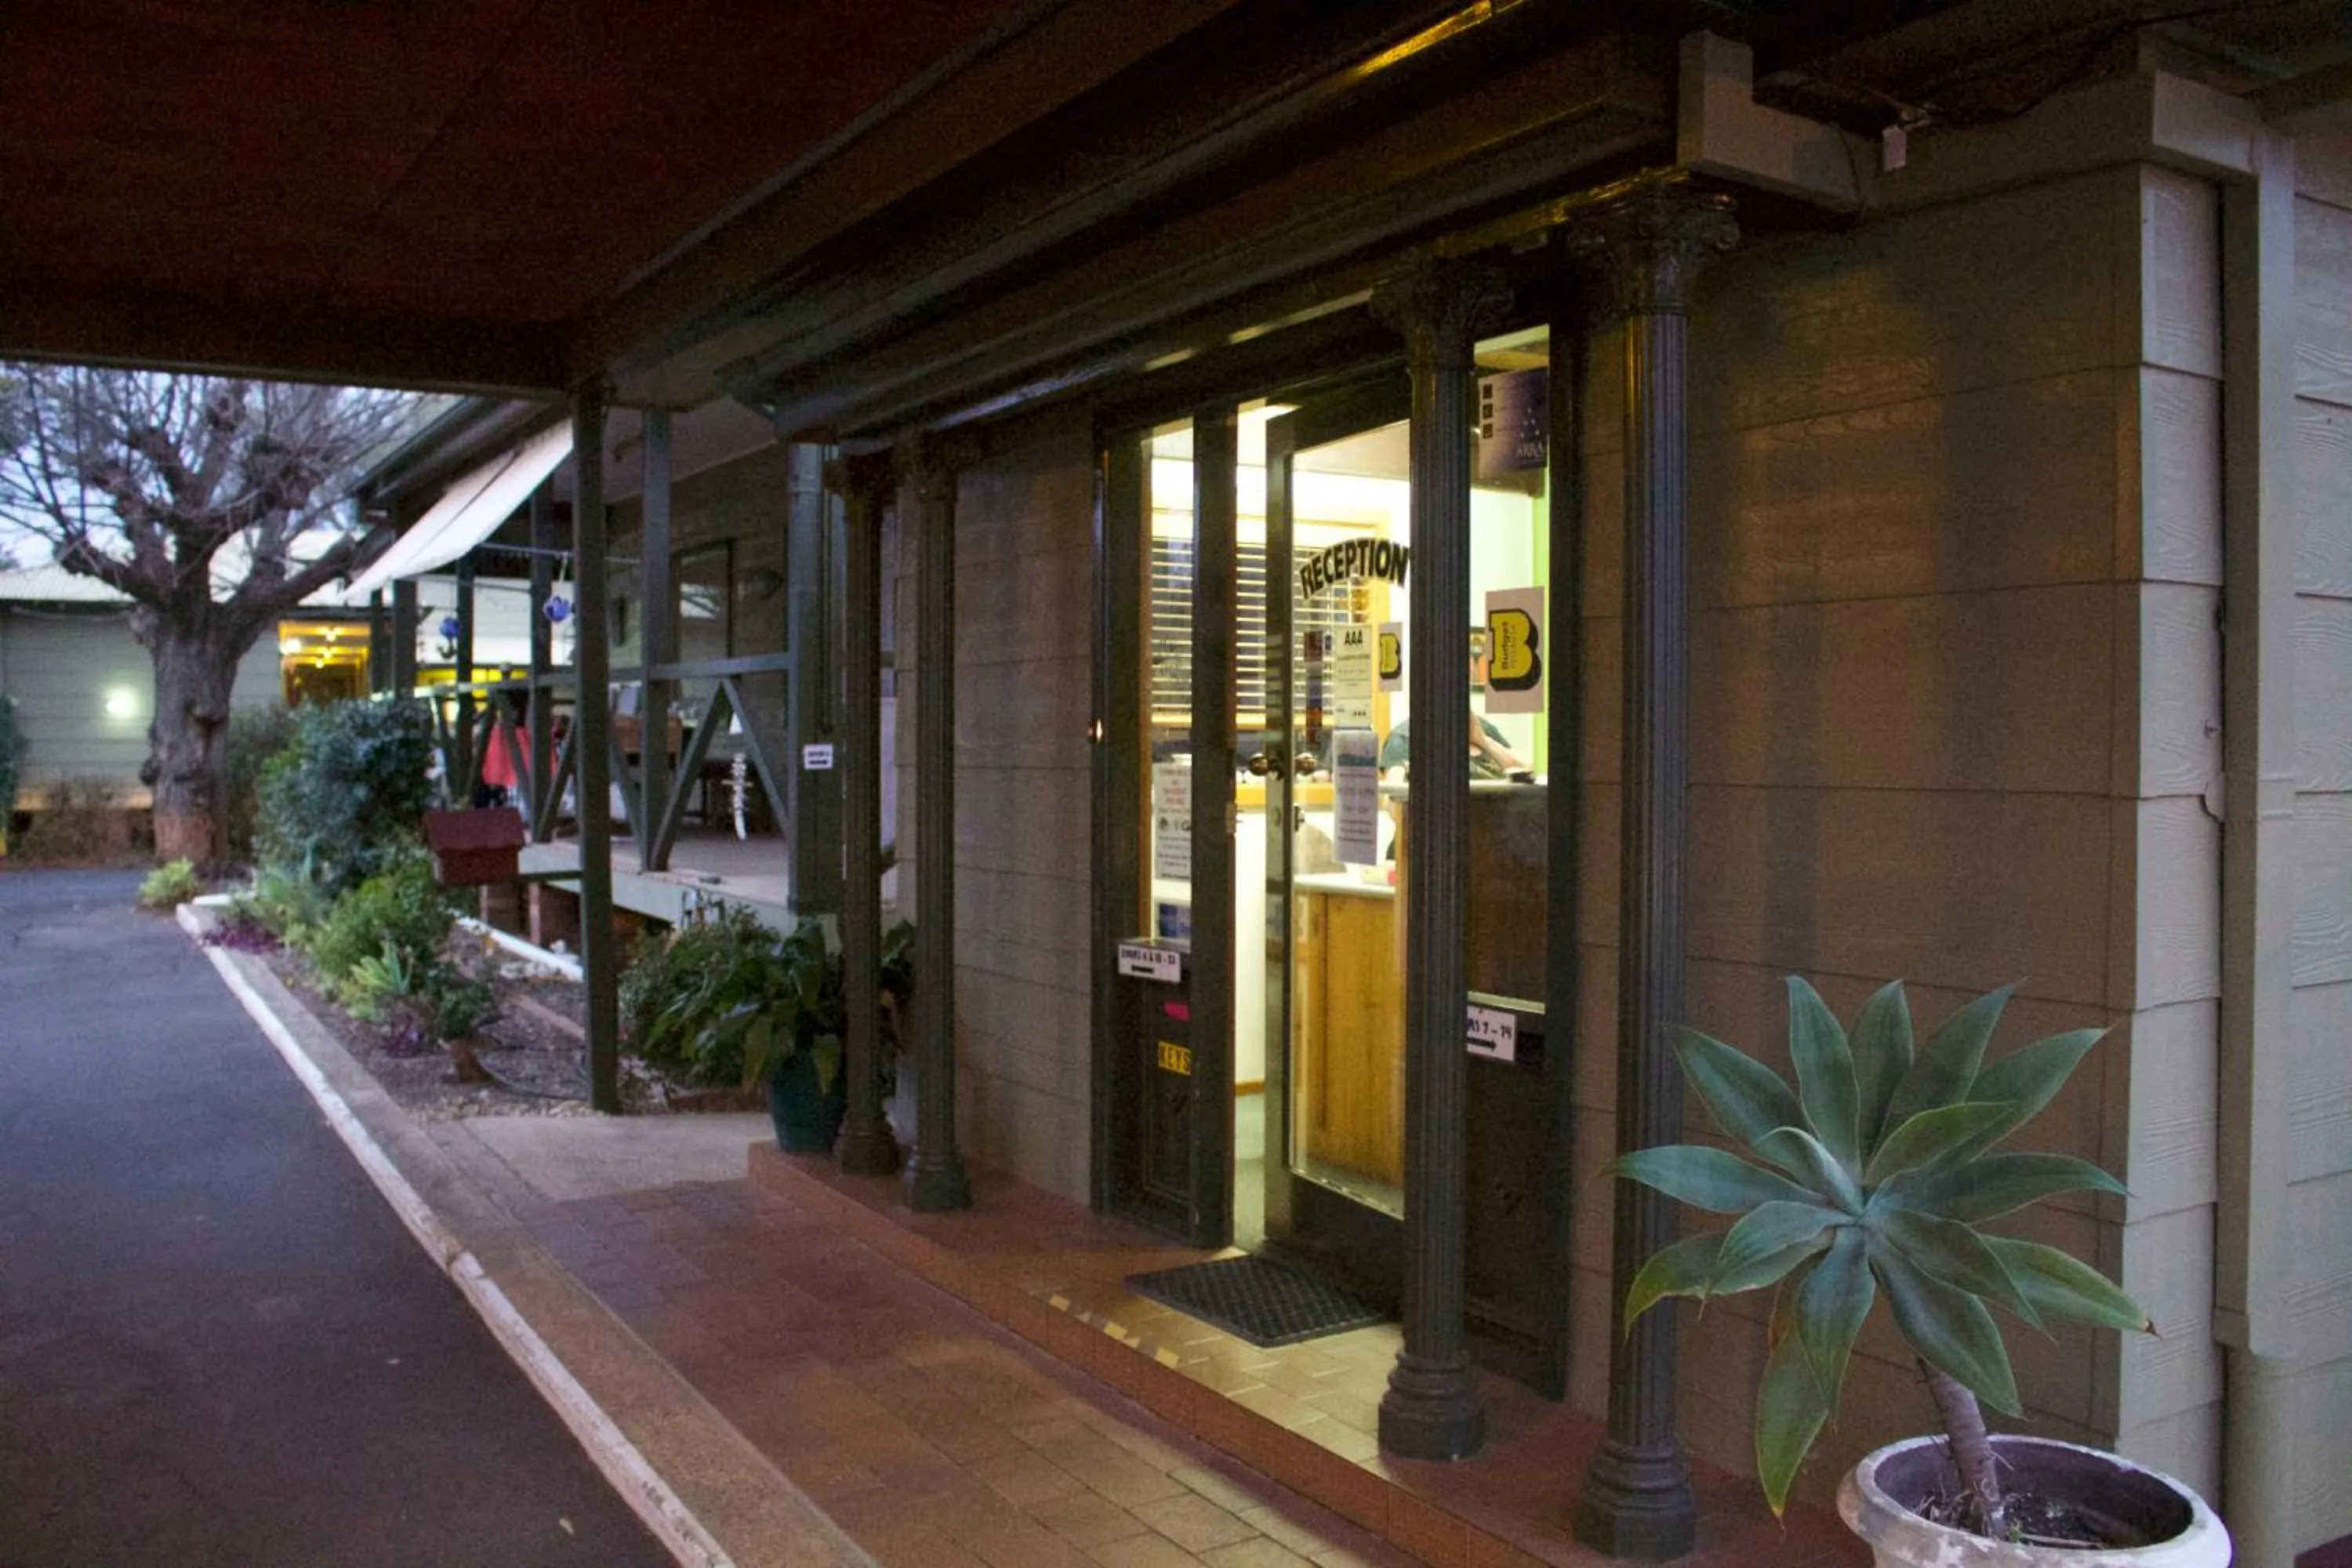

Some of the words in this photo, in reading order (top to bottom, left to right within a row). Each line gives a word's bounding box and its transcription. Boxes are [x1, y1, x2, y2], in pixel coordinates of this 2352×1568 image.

[1299, 538, 1410, 600] RECEPTION
[1345, 630, 1363, 644] AAA
[1160, 1045, 1190, 1073] KEYS
